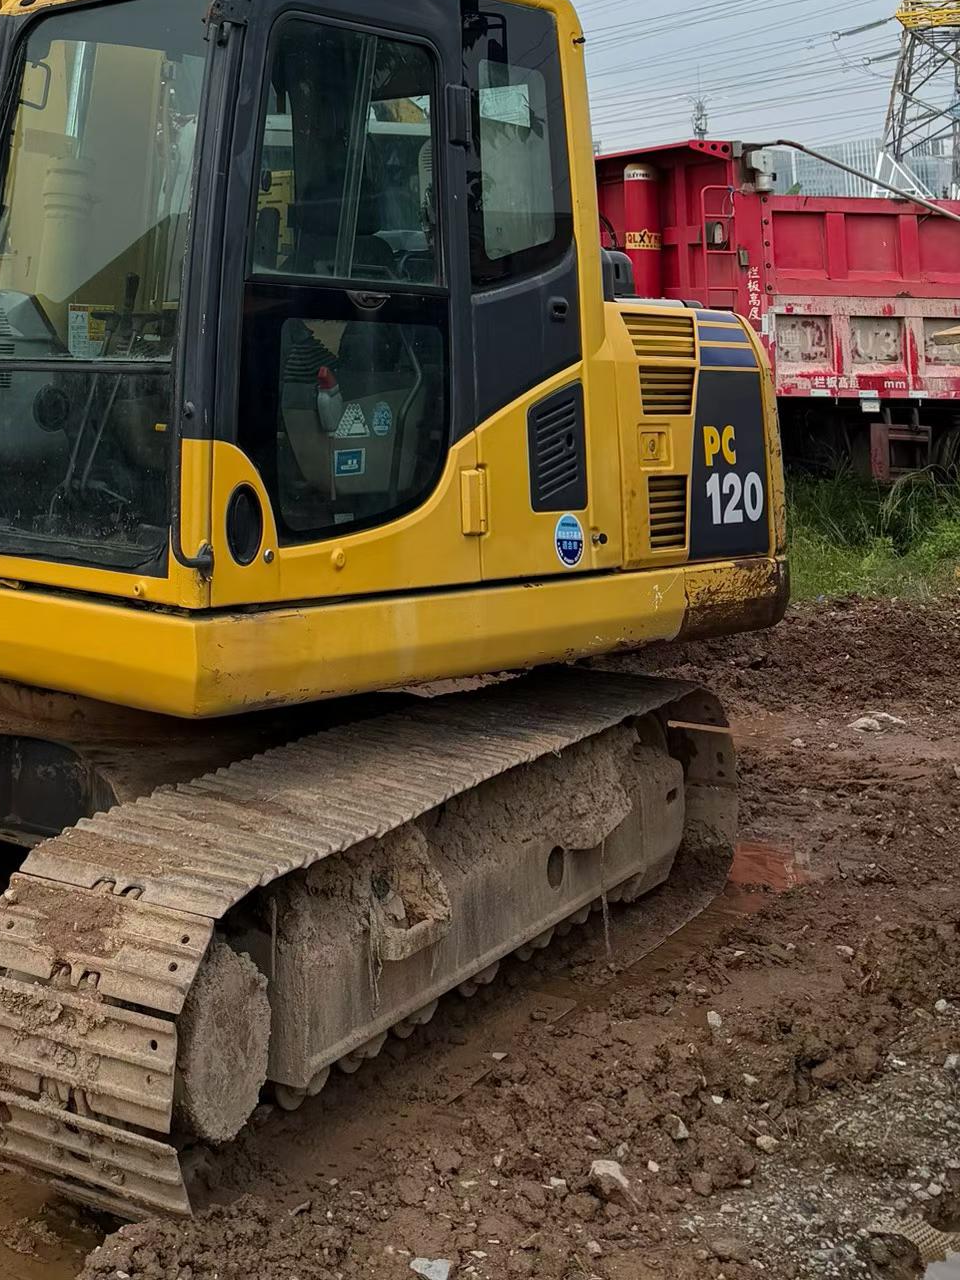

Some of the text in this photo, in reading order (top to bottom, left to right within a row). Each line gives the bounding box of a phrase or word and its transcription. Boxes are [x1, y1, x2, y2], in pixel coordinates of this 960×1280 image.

[747, 266, 762, 320] 栏板高度
[884, 381, 906, 389] mm
[703, 425, 736, 466] PC
[706, 471, 764, 525] 120
